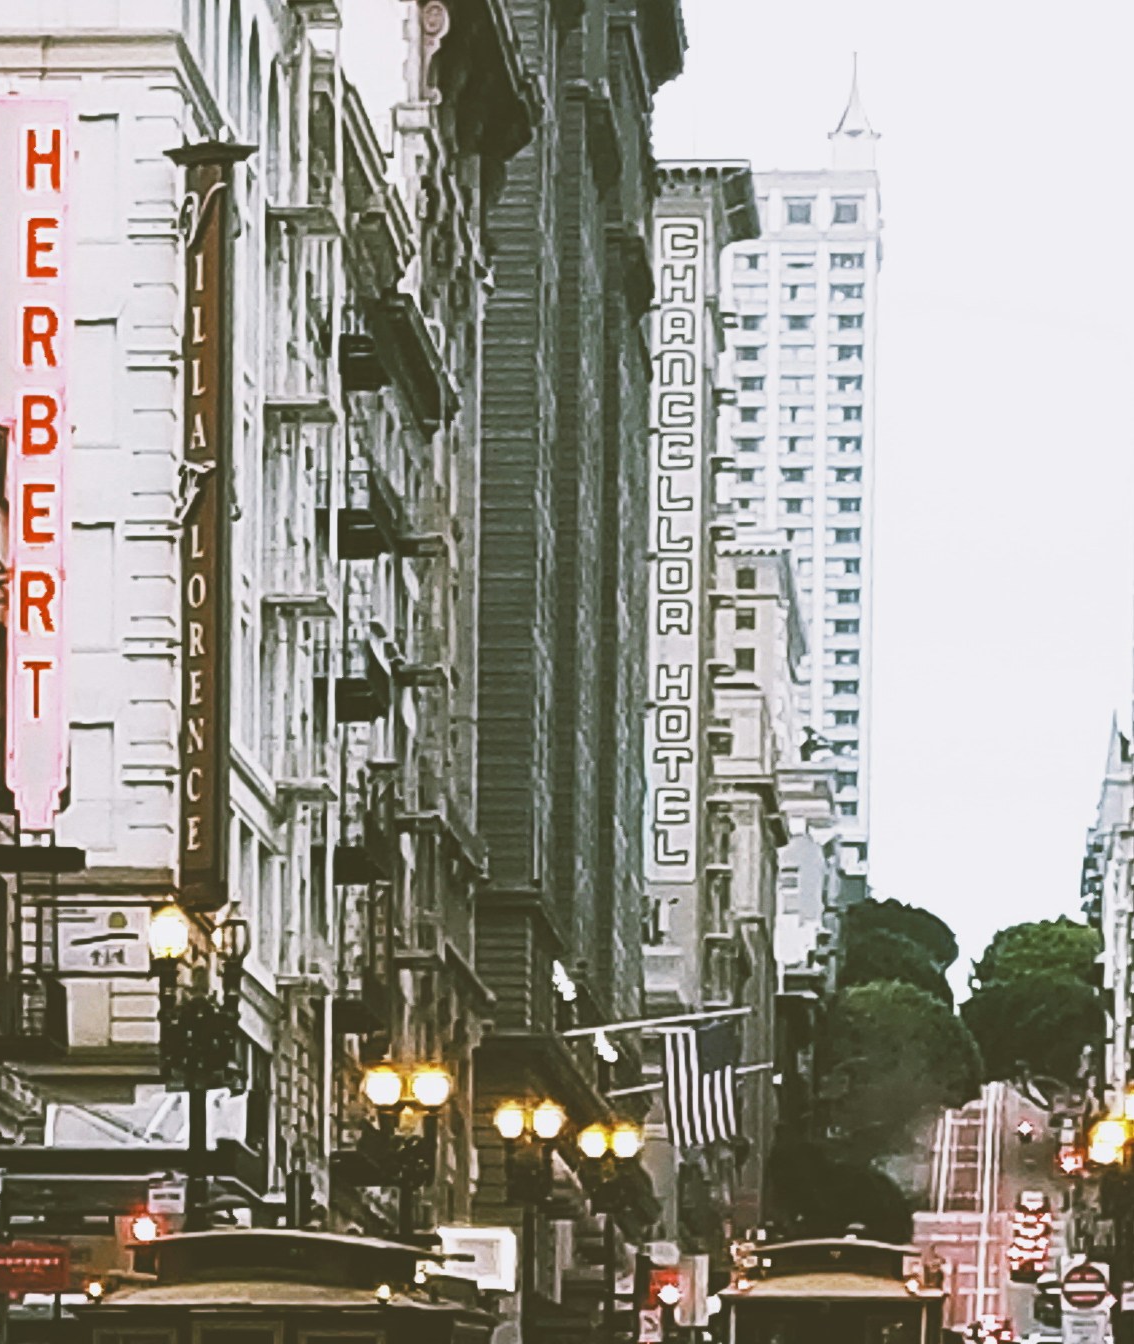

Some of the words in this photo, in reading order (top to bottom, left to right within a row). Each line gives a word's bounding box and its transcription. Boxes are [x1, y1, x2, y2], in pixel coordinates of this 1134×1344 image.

[19, 128, 62, 719] HERBERT
[179, 182, 227, 450] VILLA
[657, 223, 698, 635] CHANCELLOR
[653, 664, 693, 866] HOTEL
